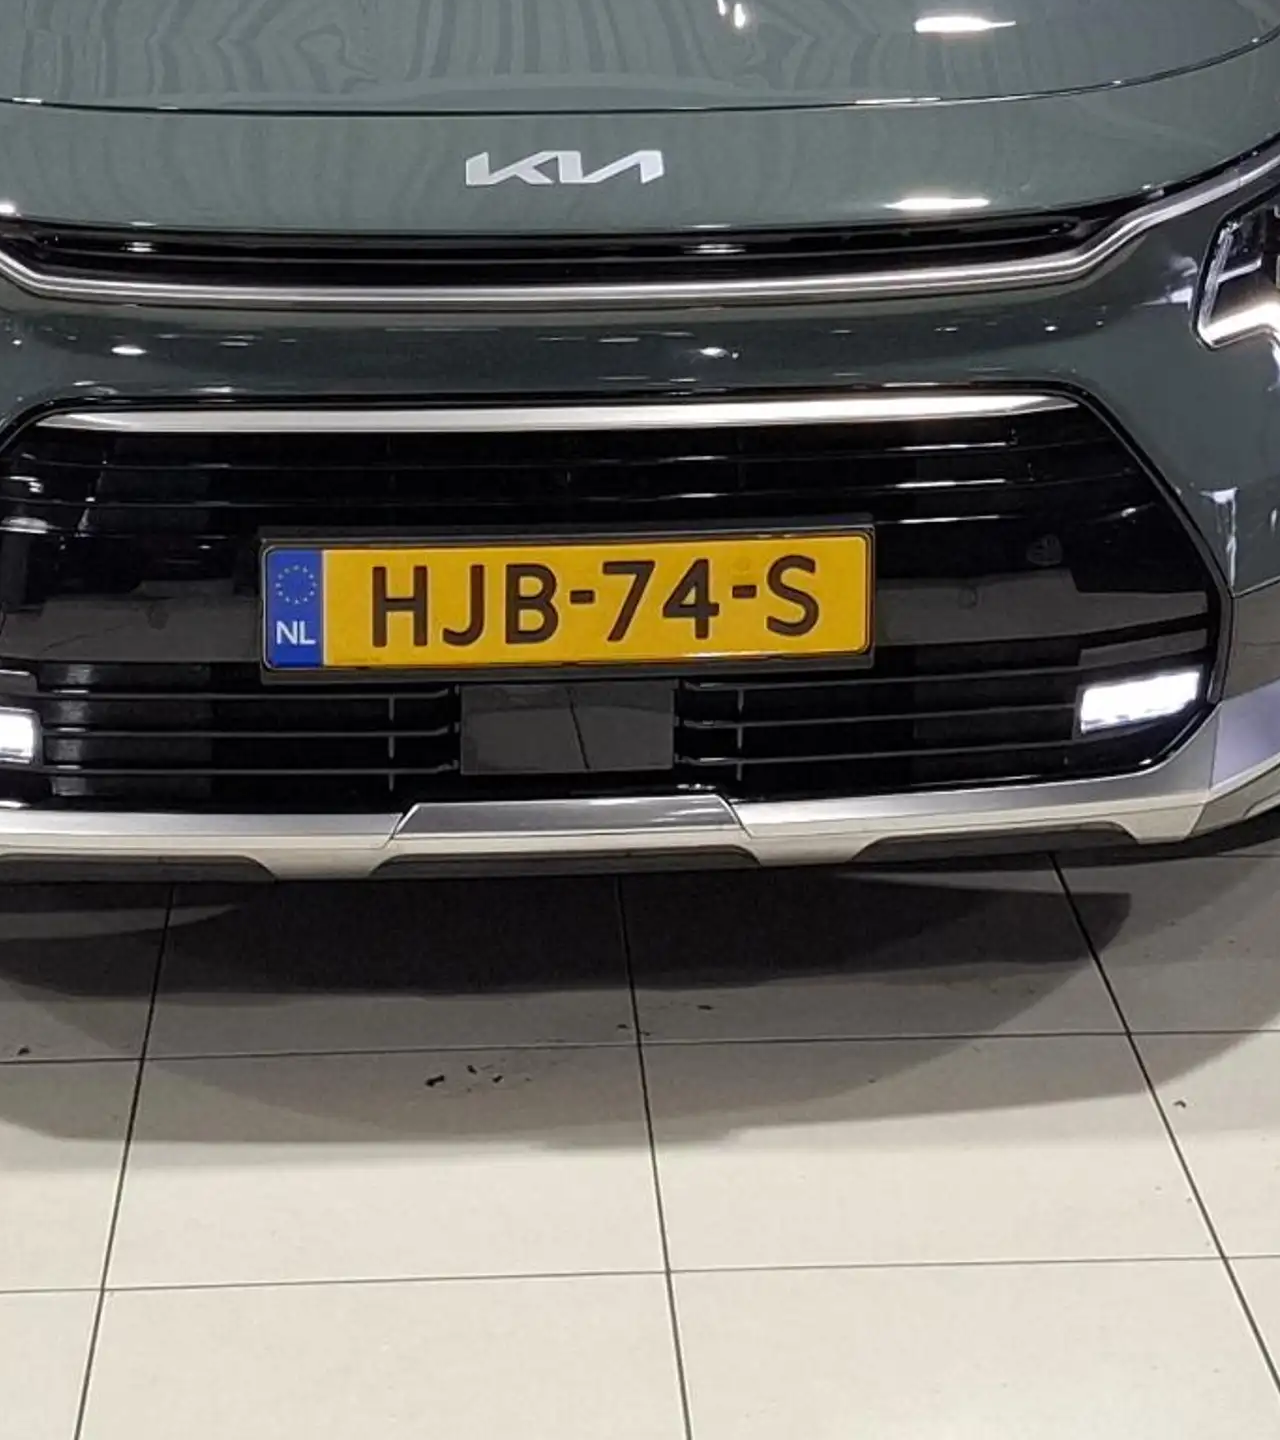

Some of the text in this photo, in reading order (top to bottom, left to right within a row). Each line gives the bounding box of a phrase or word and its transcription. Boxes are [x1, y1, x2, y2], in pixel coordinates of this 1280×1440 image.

[465, 149, 665, 185] KIA
[372, 555, 820, 648] HJB-74-S
[276, 620, 316, 645] NL
